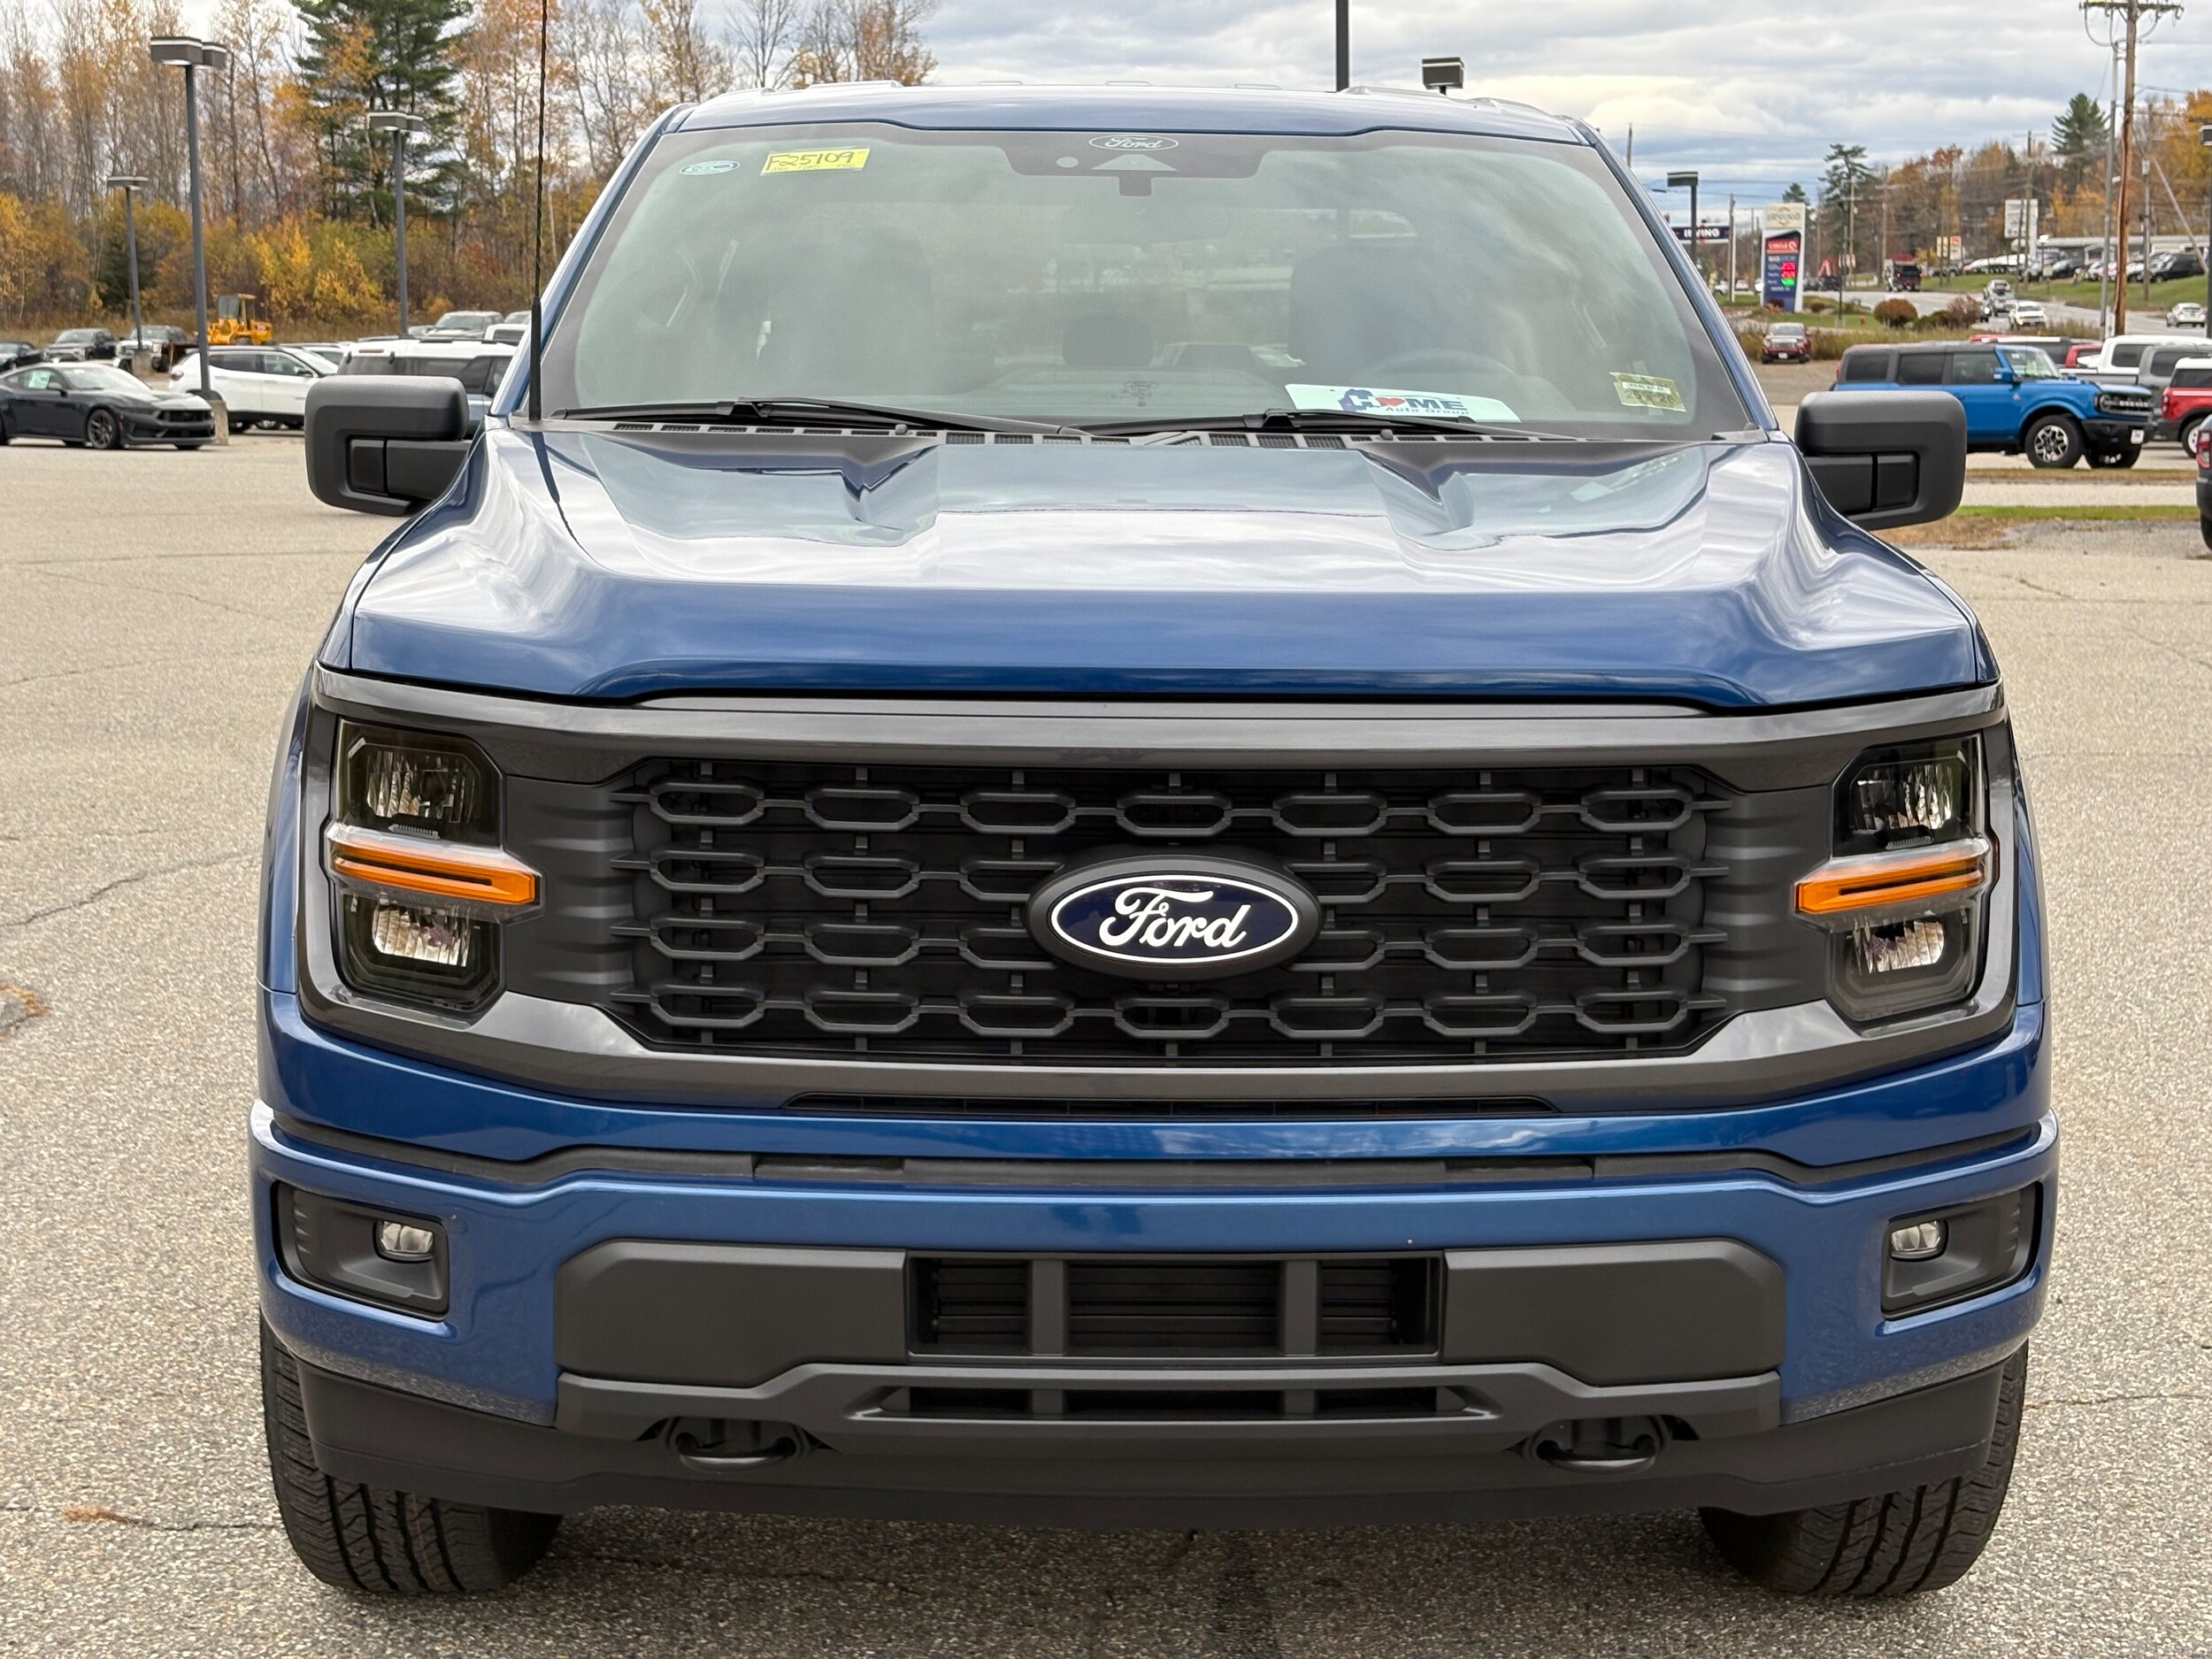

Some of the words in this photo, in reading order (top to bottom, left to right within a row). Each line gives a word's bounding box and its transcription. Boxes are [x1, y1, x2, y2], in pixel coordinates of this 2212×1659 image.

[1104, 136, 1163, 149] Ford
[766, 151, 855, 171] F25109
[1099, 887, 1251, 948] Ford
